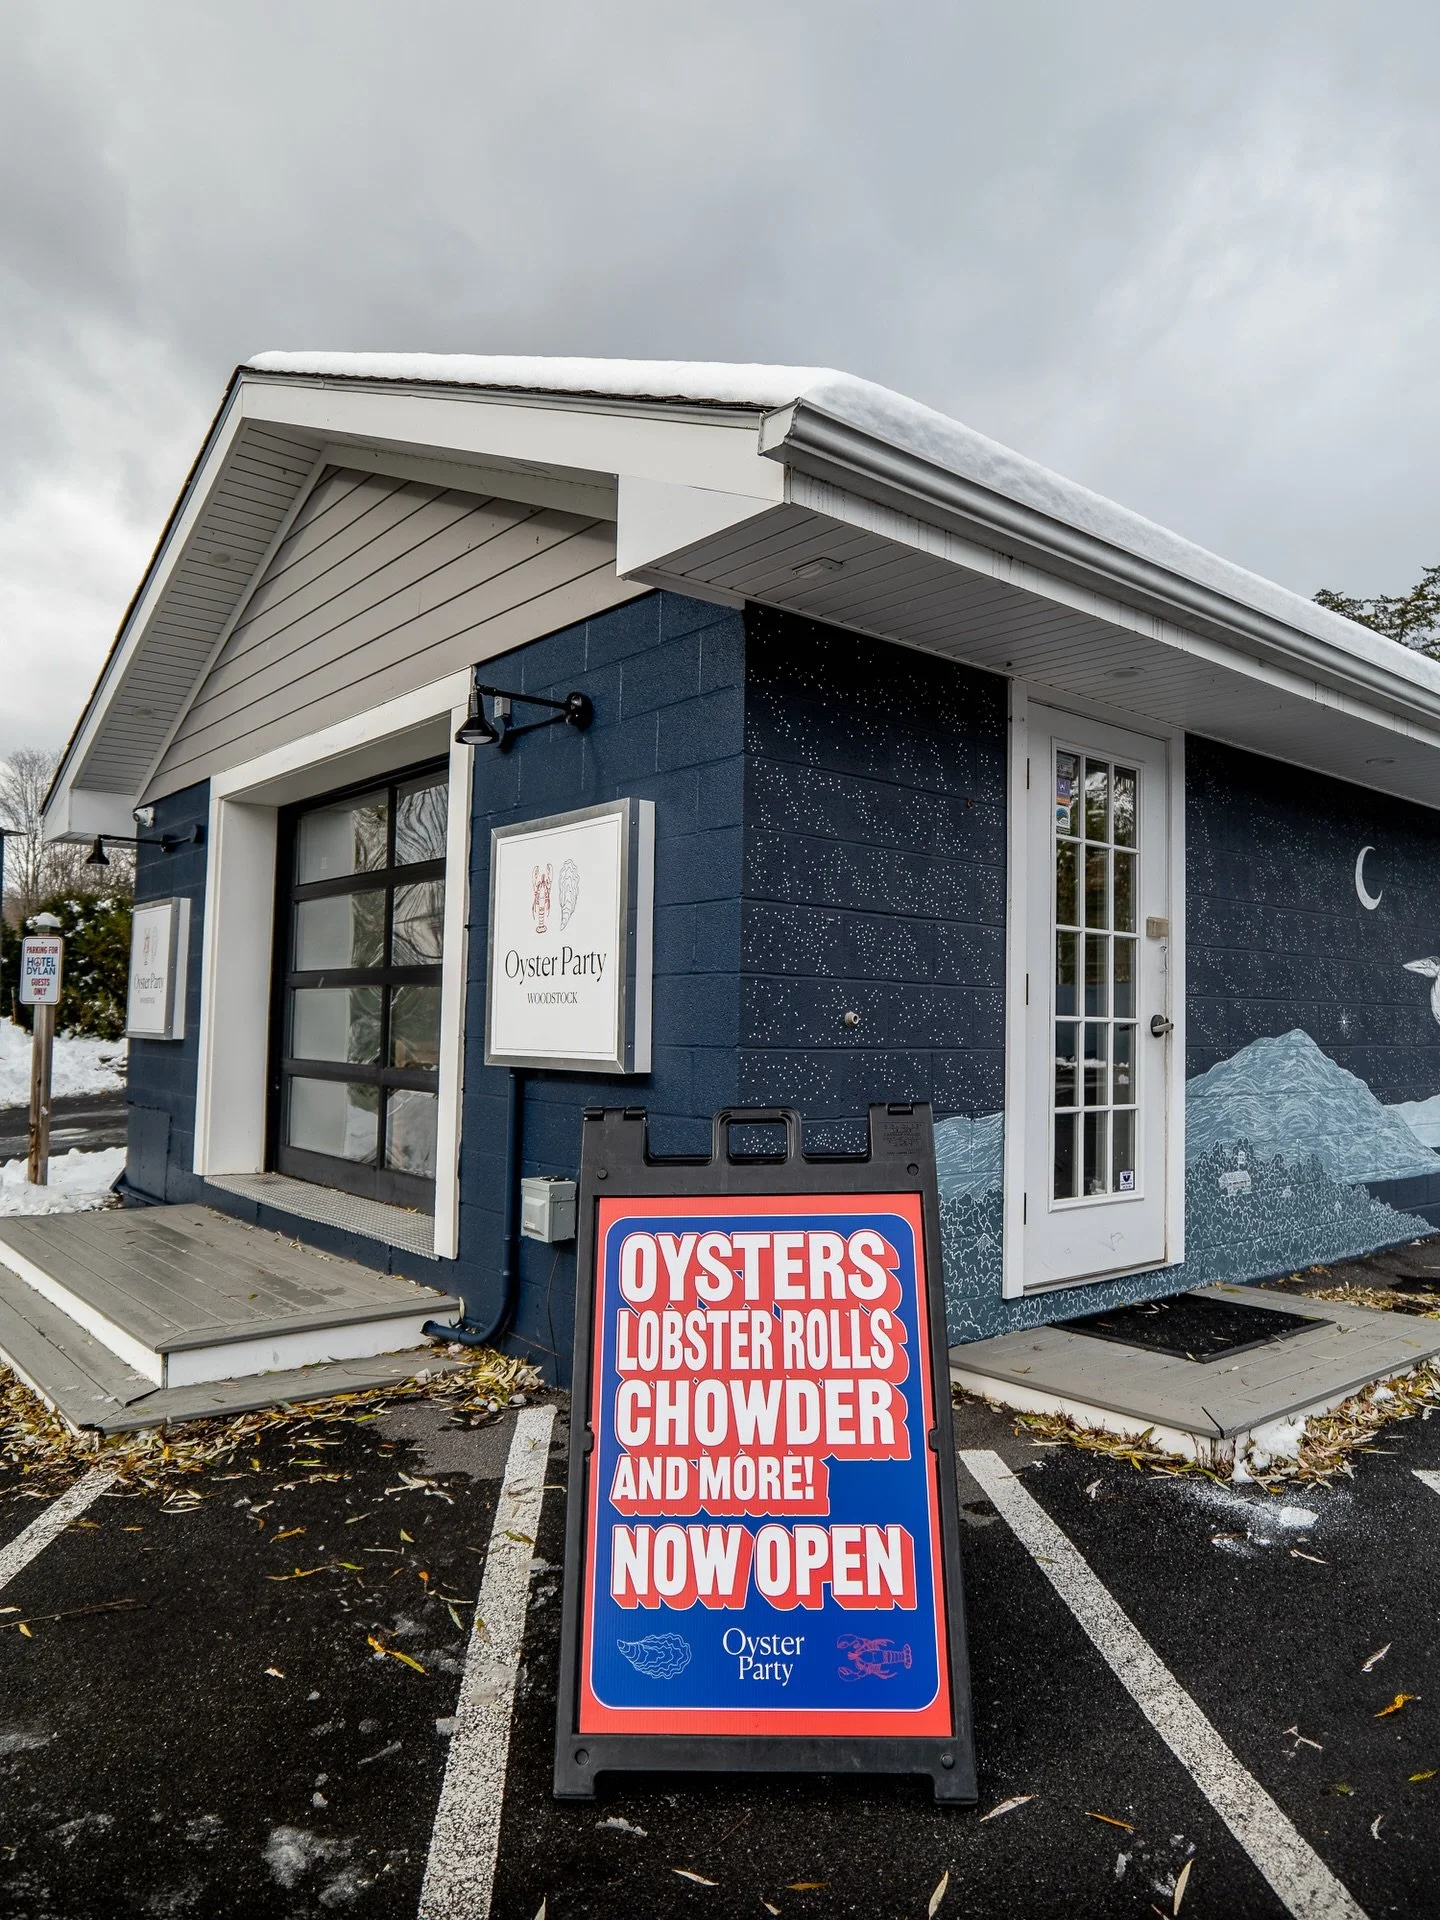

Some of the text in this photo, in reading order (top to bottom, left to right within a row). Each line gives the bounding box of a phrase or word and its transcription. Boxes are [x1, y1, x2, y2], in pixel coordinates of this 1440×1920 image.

[27, 946, 58, 954] PARKING FOR
[27, 957, 56, 967] HOTEL
[505, 945, 607, 985] Oyster Party
[27, 967, 56, 976] DYLAN
[31, 978, 50, 986] GUESTS
[33, 988, 47, 996] ONLY
[527, 991, 578, 1005] WOODSTOCK
[620, 1230, 888, 1303] OYSTERS
[618, 1307, 894, 1371] LOBSTER ROLLS
[616, 1378, 896, 1447] CHOWDER
[611, 1455, 815, 1501] AND MORE!
[612, 1525, 905, 1596] NOW OPEN
[722, 1627, 805, 1663] Oyster
[738, 1656, 794, 1687] Party
